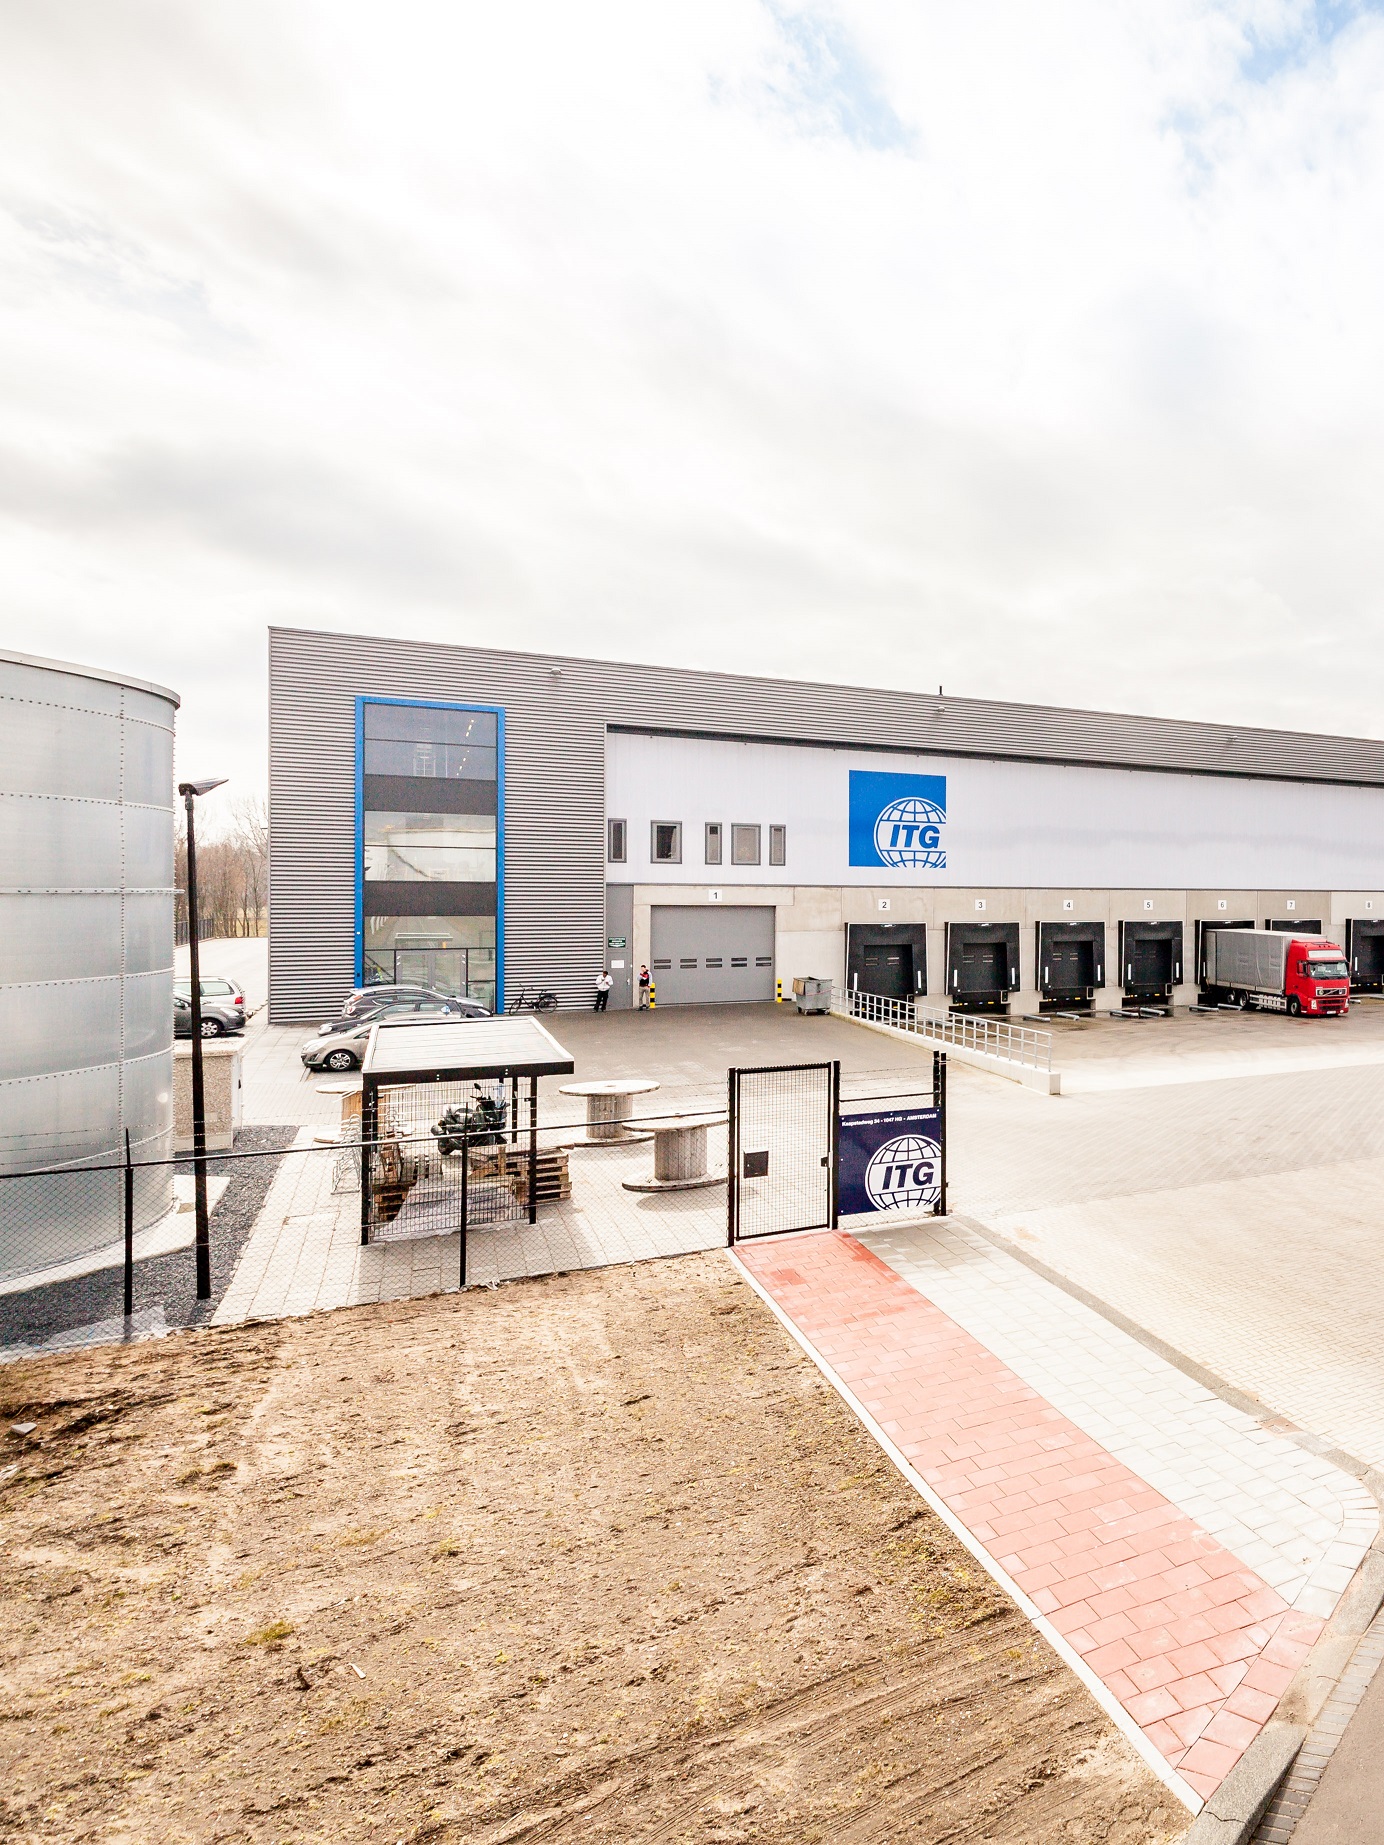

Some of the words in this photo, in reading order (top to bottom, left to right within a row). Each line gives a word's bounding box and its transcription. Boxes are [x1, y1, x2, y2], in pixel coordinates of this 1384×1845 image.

[890, 824, 940, 849] ITG
[906, 1113, 937, 1121] AMSTERDAM
[883, 1162, 934, 1190] ITG
